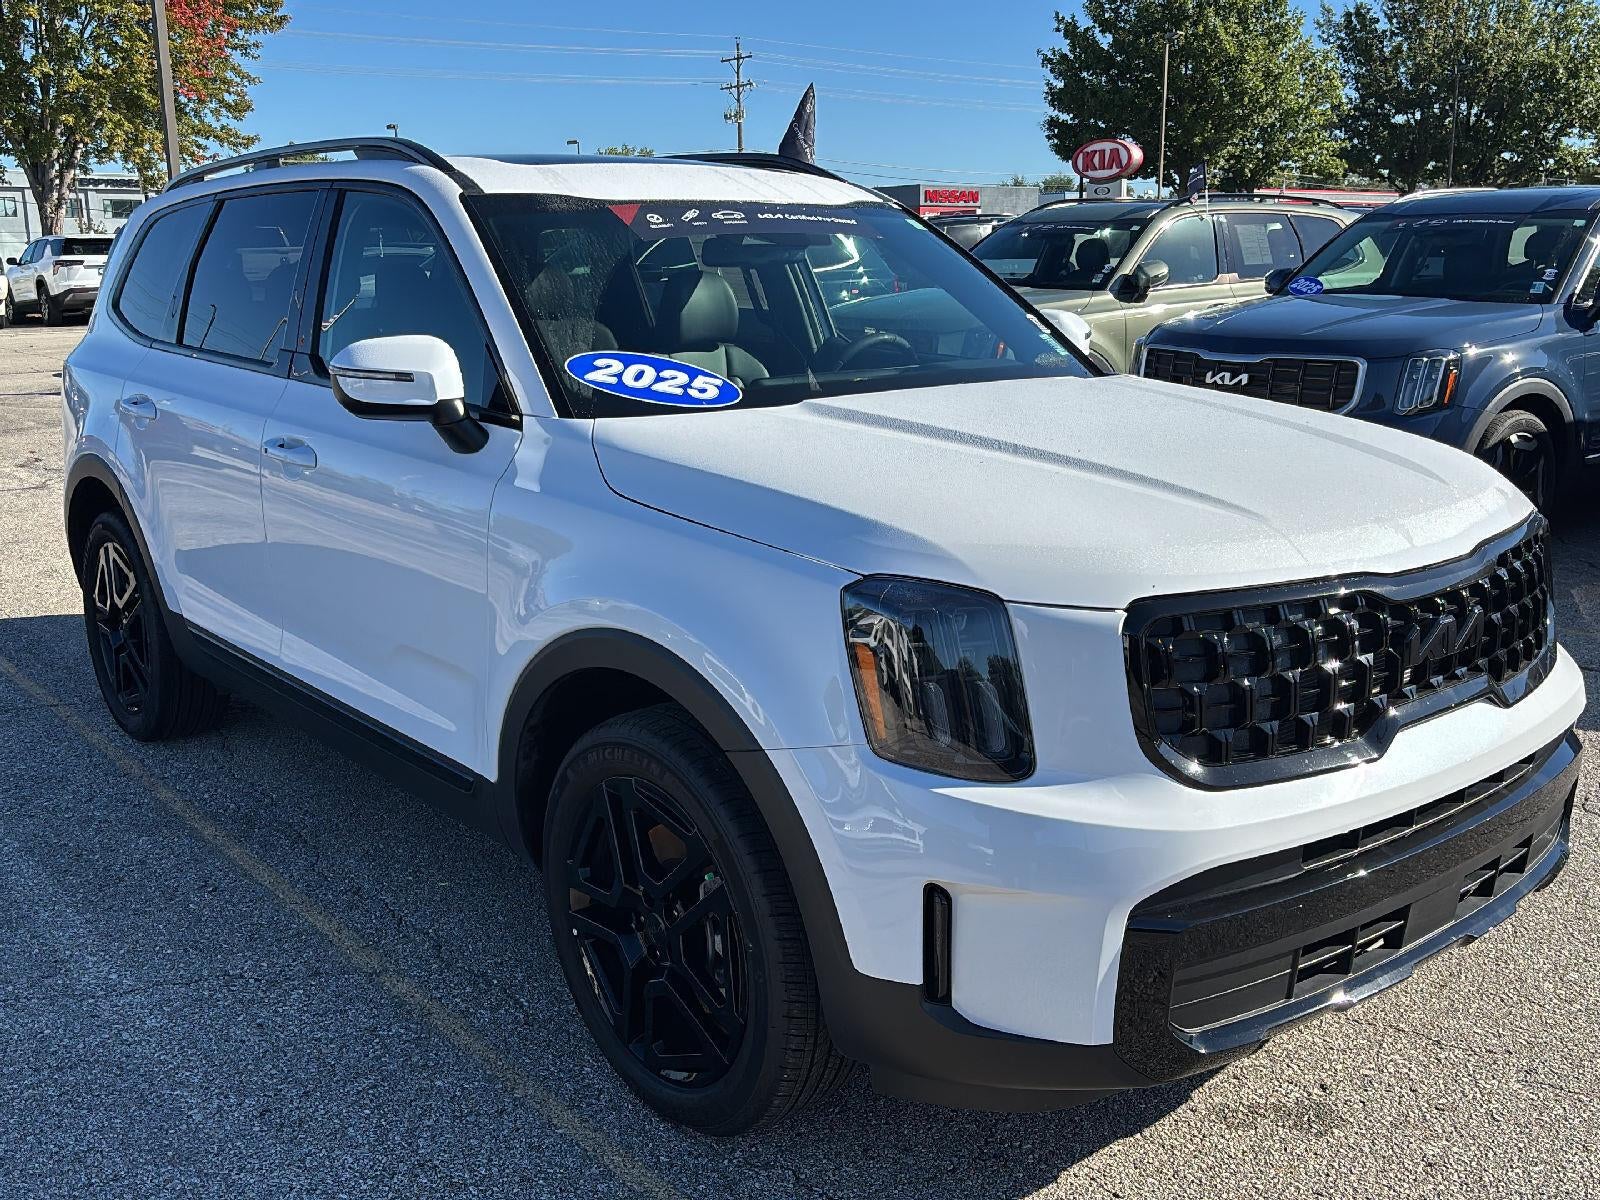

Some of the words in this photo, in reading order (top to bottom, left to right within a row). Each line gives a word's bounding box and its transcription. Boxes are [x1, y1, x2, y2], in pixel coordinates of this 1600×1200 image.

[1081, 148, 1123, 172] KIA
[924, 189, 979, 203] NISSAN
[584, 358, 724, 400] 2025
[1205, 371, 1249, 386] KIA
[587, 748, 664, 778] MICHELIN
